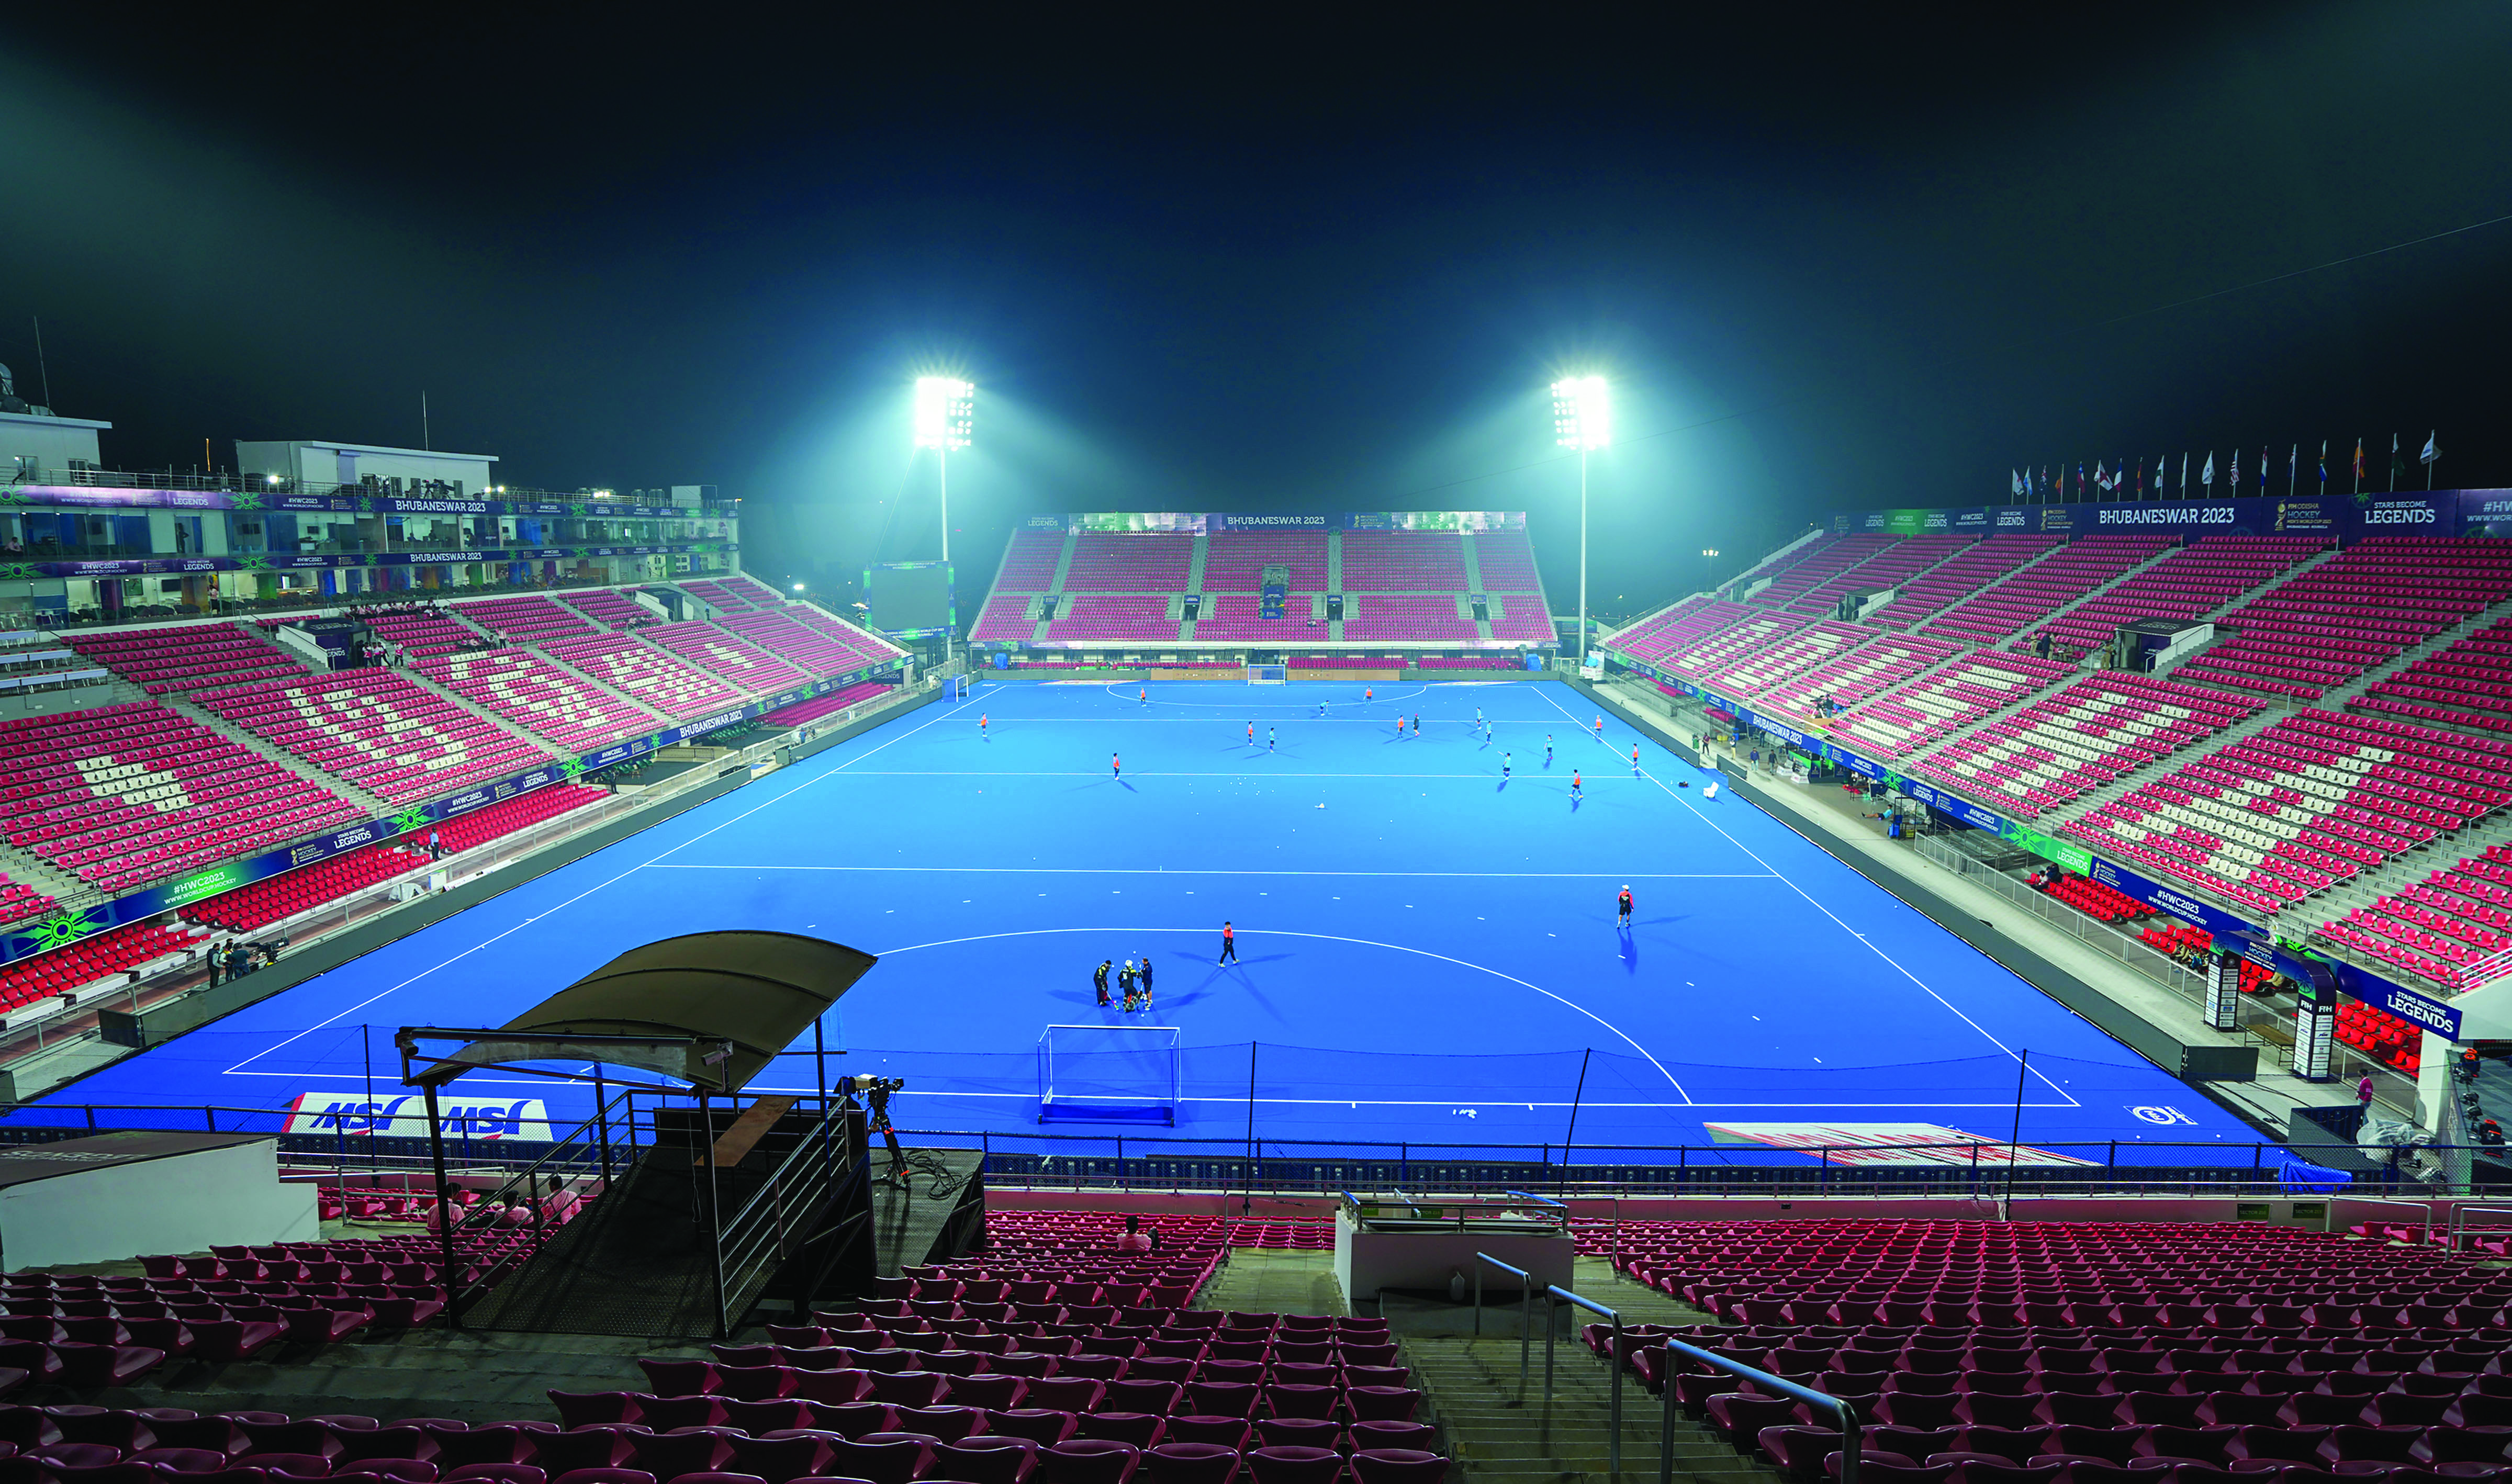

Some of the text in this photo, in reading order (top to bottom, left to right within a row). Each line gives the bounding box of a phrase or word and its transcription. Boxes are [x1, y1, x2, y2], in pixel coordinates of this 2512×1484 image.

[395, 500, 486, 512] BHUBANESWAR 2023
[1924, 519, 1947, 527] LEGENDS
[1997, 516, 2025, 526] LEGENDS
[2099, 508, 2234, 524] BHUBANESWAR 2023
[2365, 509, 2435, 523] LEGENDS
[410, 552, 482, 563] BHUBANESWAR 2023
[679, 710, 743, 738] BHUBANESWAR 2023
[1753, 713, 1802, 746] BHUBANESWAR 2023
[523, 774, 548, 788] LEGENDS
[452, 791, 483, 806] #HWC2023
[1913, 787, 1933, 802] LEGENDS
[1969, 808, 1995, 824] #HWC2023
[349, 827, 365, 836] BECOME
[334, 830, 372, 849] LEGENDS
[298, 847, 317, 856] HOCKEY
[2072, 851, 2085, 860] BECOME
[2057, 850, 2088, 871] LEGENDS
[2100, 869, 2116, 879] HOCKEY
[174, 872, 225, 894] #HWC2023
[164, 878, 237, 904] WWW.WORLDCUP.HOCKEY
[2157, 890, 2200, 914] #HWC2023
[2148, 895, 2207, 925] WWW.WORLDCUP.HOCKEY
[2249, 947, 2272, 961] HOCKEY
[2301, 999, 2312, 1010] FIH
[2396, 991, 2447, 1016] STARS BECOME
[2387, 994, 2454, 1033] LEGENDS
